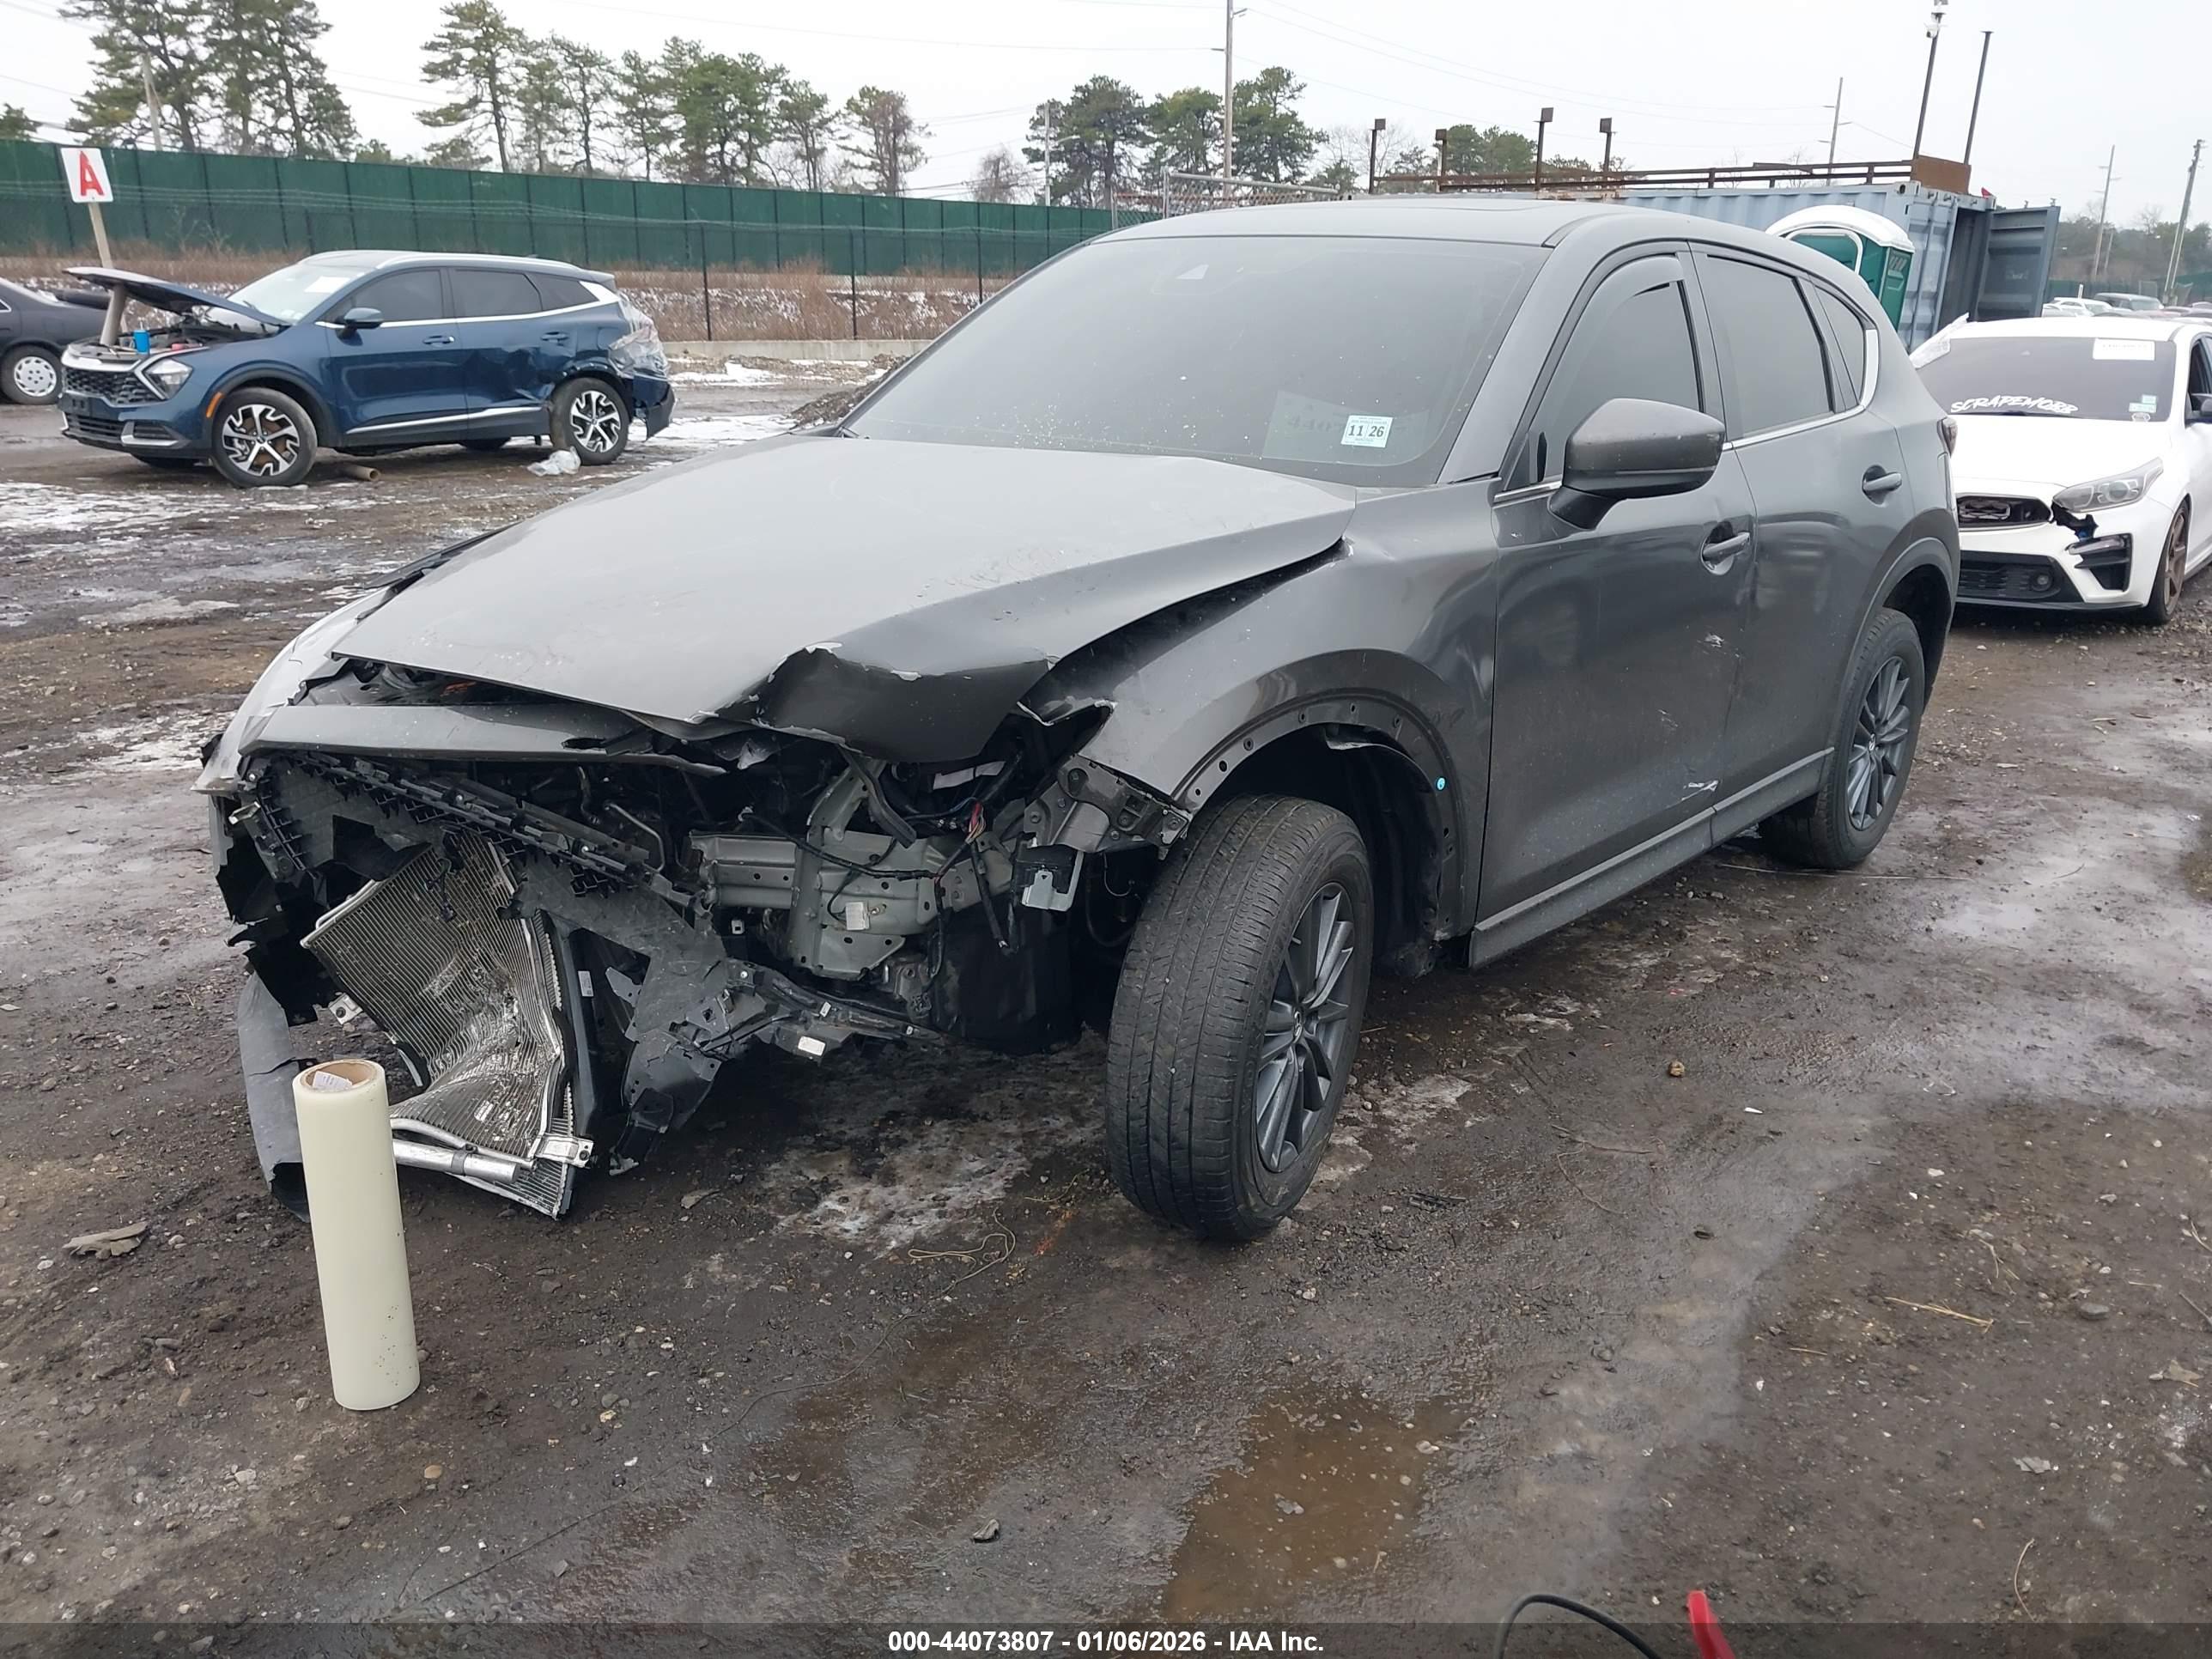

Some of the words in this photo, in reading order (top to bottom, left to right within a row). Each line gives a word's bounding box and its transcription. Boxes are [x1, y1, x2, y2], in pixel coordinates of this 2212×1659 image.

[79, 150, 104, 196] A
[1348, 425, 1363, 436] 11
[1368, 425, 1385, 437] 26
